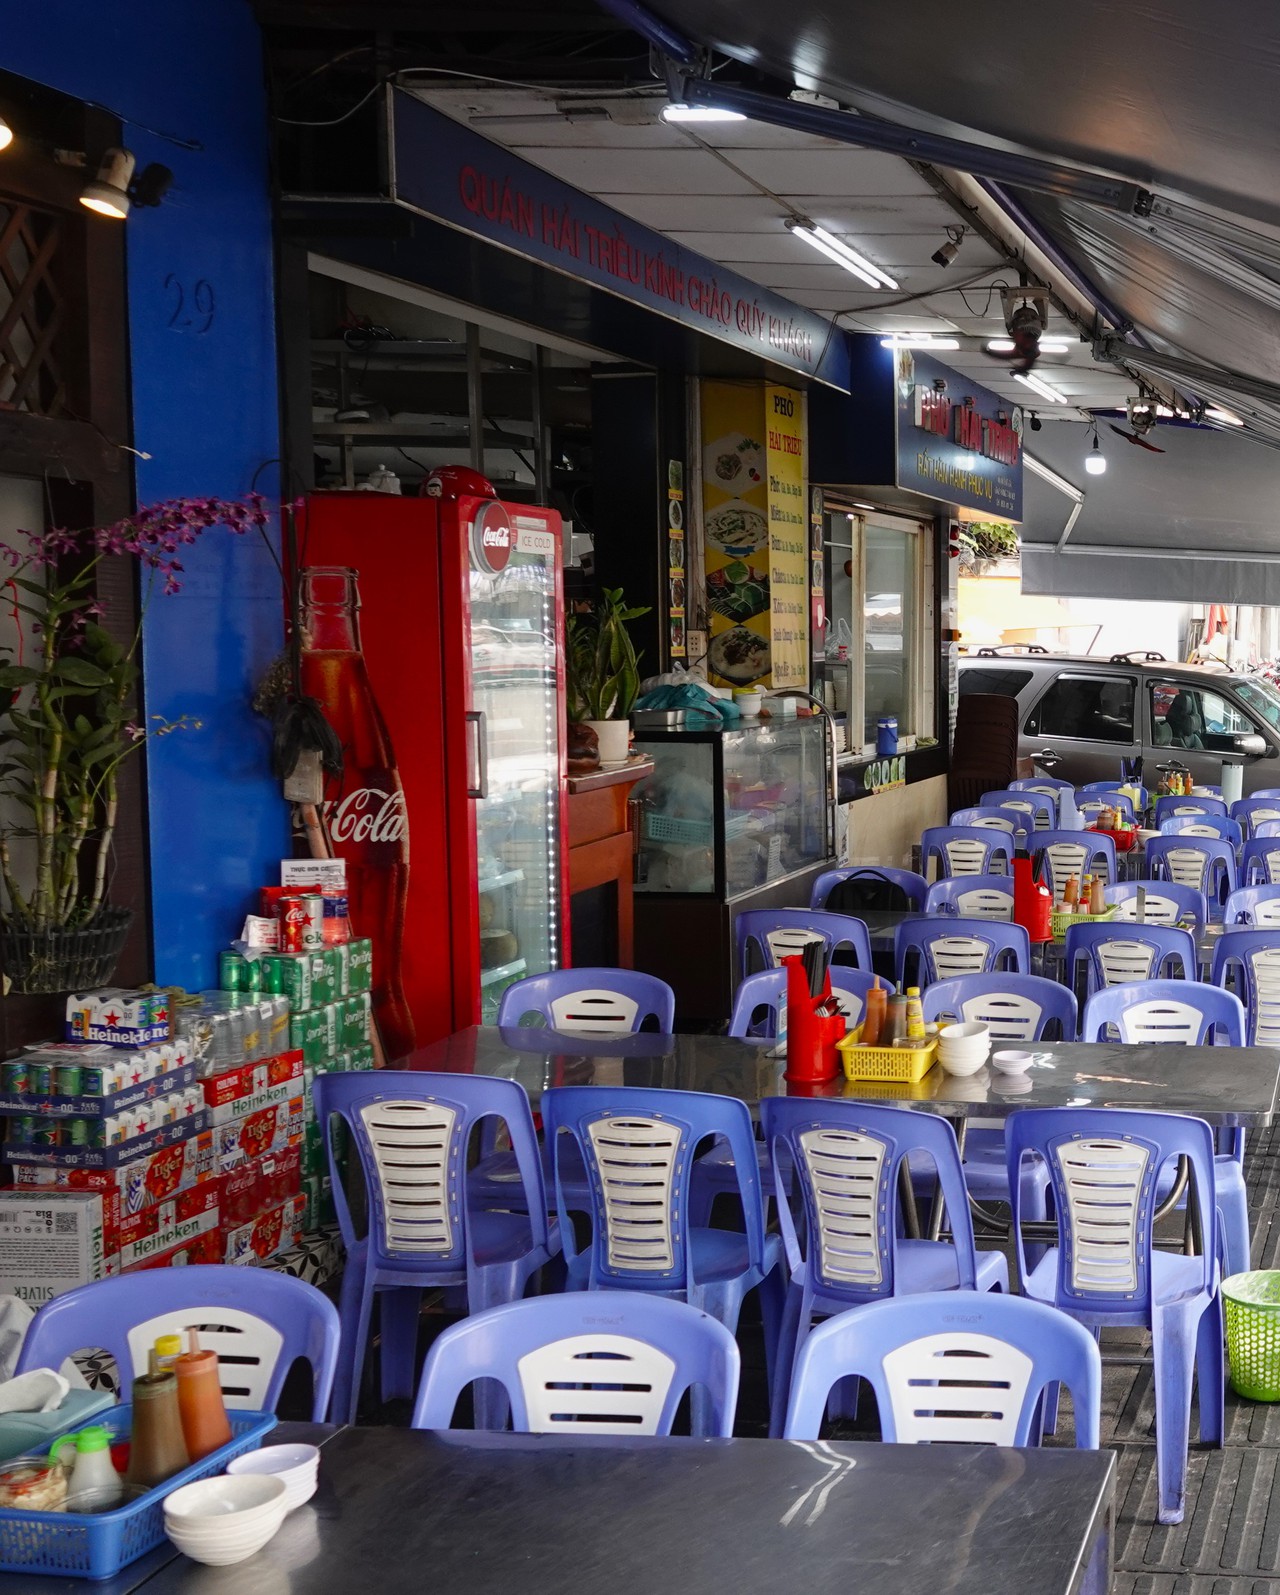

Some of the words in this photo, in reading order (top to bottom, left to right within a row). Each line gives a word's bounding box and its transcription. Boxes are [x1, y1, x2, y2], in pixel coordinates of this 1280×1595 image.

[459, 167, 534, 237] QUÁN
[542, 204, 582, 259] HẢI
[584, 221, 642, 285] TRIỀU
[644, 253, 685, 307] KÍNH
[687, 276, 732, 325] CHÀO
[735, 298, 767, 341] QUÝ
[769, 313, 814, 364] KHÁCH
[164, 272, 215, 334] 29
[773, 393, 795, 418] PHỞ
[483, 526, 510, 548] Coca-Cola
[521, 535, 532, 547] ICE
[534, 537, 551, 549] COLD
[88, 1028, 138, 1044] Heinek
[231, 1086, 288, 1116] Heineken
[246, 1118, 274, 1140] Tiger
[118, 1141, 153, 1161] Heineken
[151, 1156, 182, 1180] Tiger
[95, 1177, 107, 1186] 24
[36, 1210, 53, 1219] Bia
[132, 1220, 200, 1258] Heineken
[257, 1219, 281, 1240] Tiger
[14, 1286, 54, 1301] SILVER
